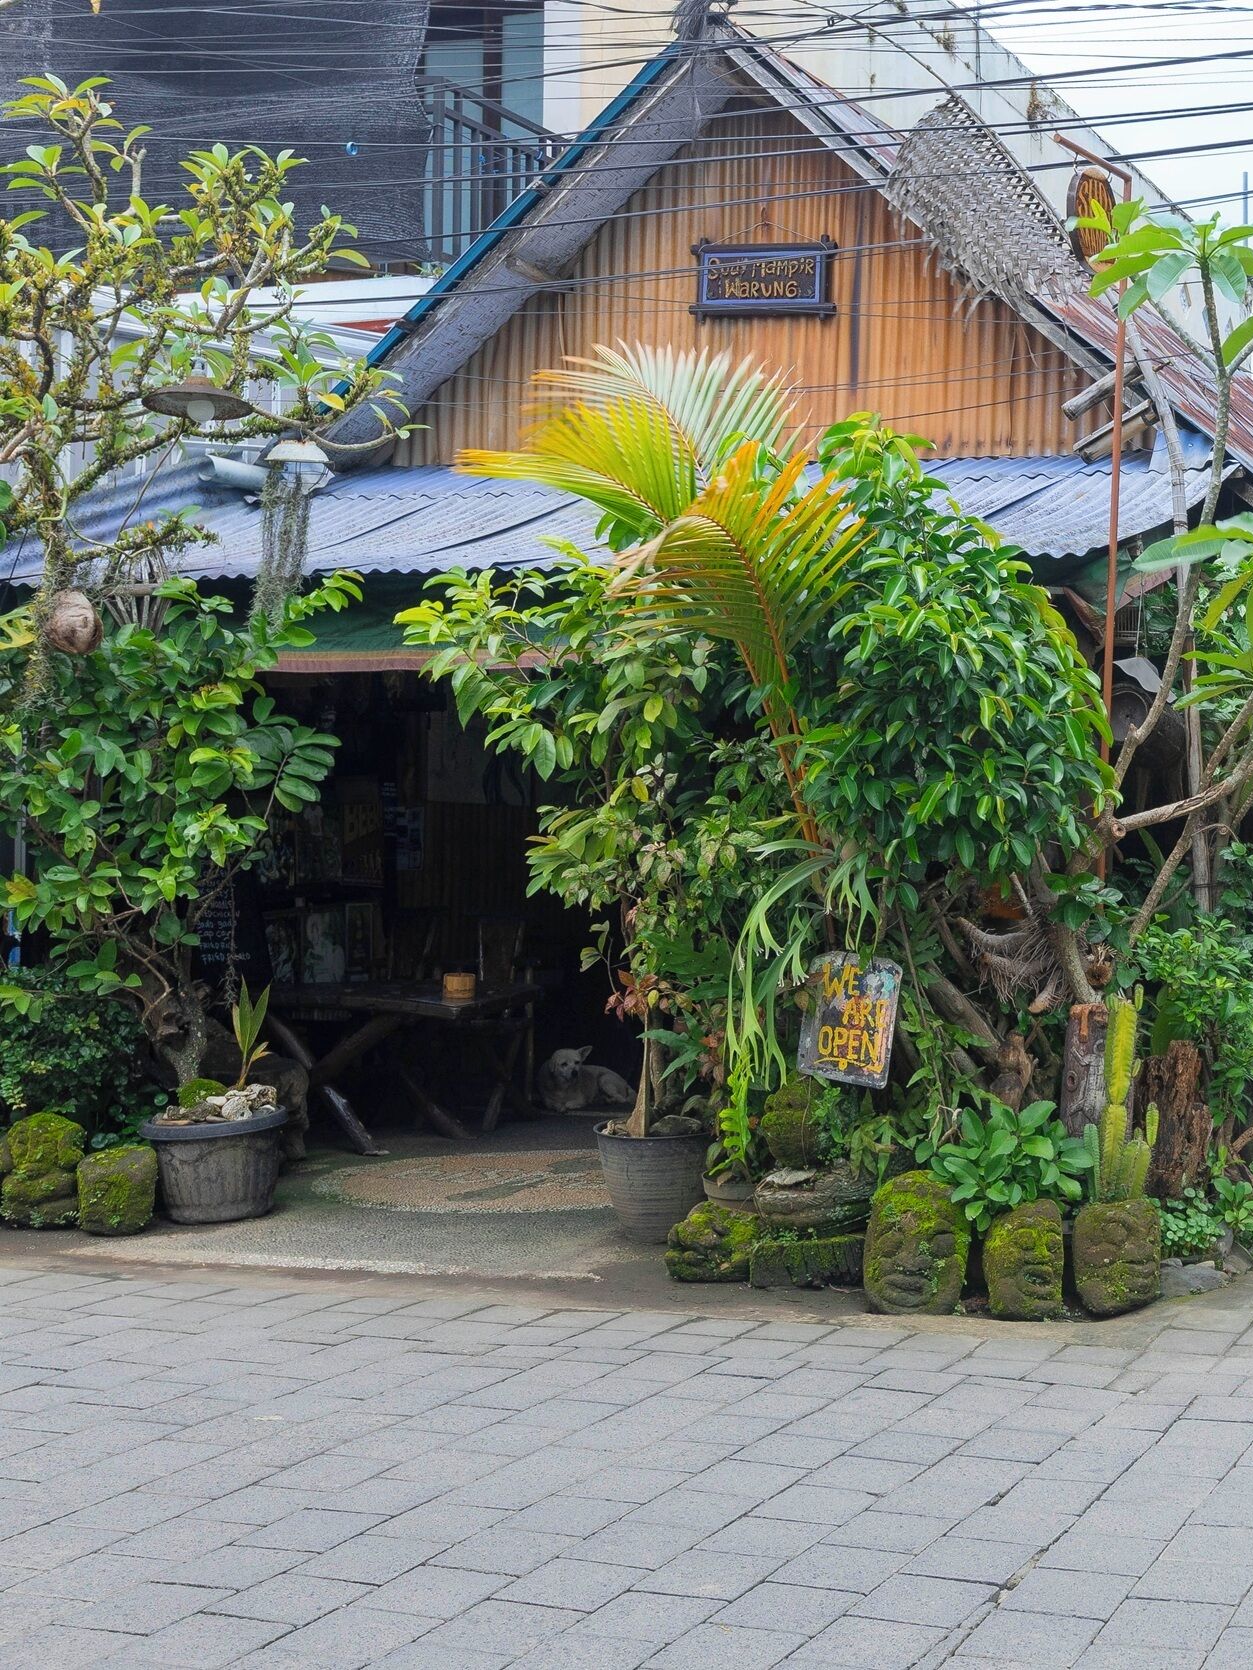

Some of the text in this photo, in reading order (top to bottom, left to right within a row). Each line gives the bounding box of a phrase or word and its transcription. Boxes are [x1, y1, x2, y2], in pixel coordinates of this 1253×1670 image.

[822, 963, 862, 996] WE
[842, 998, 888, 1029] ARE
[818, 1026, 881, 1063] OPEN
